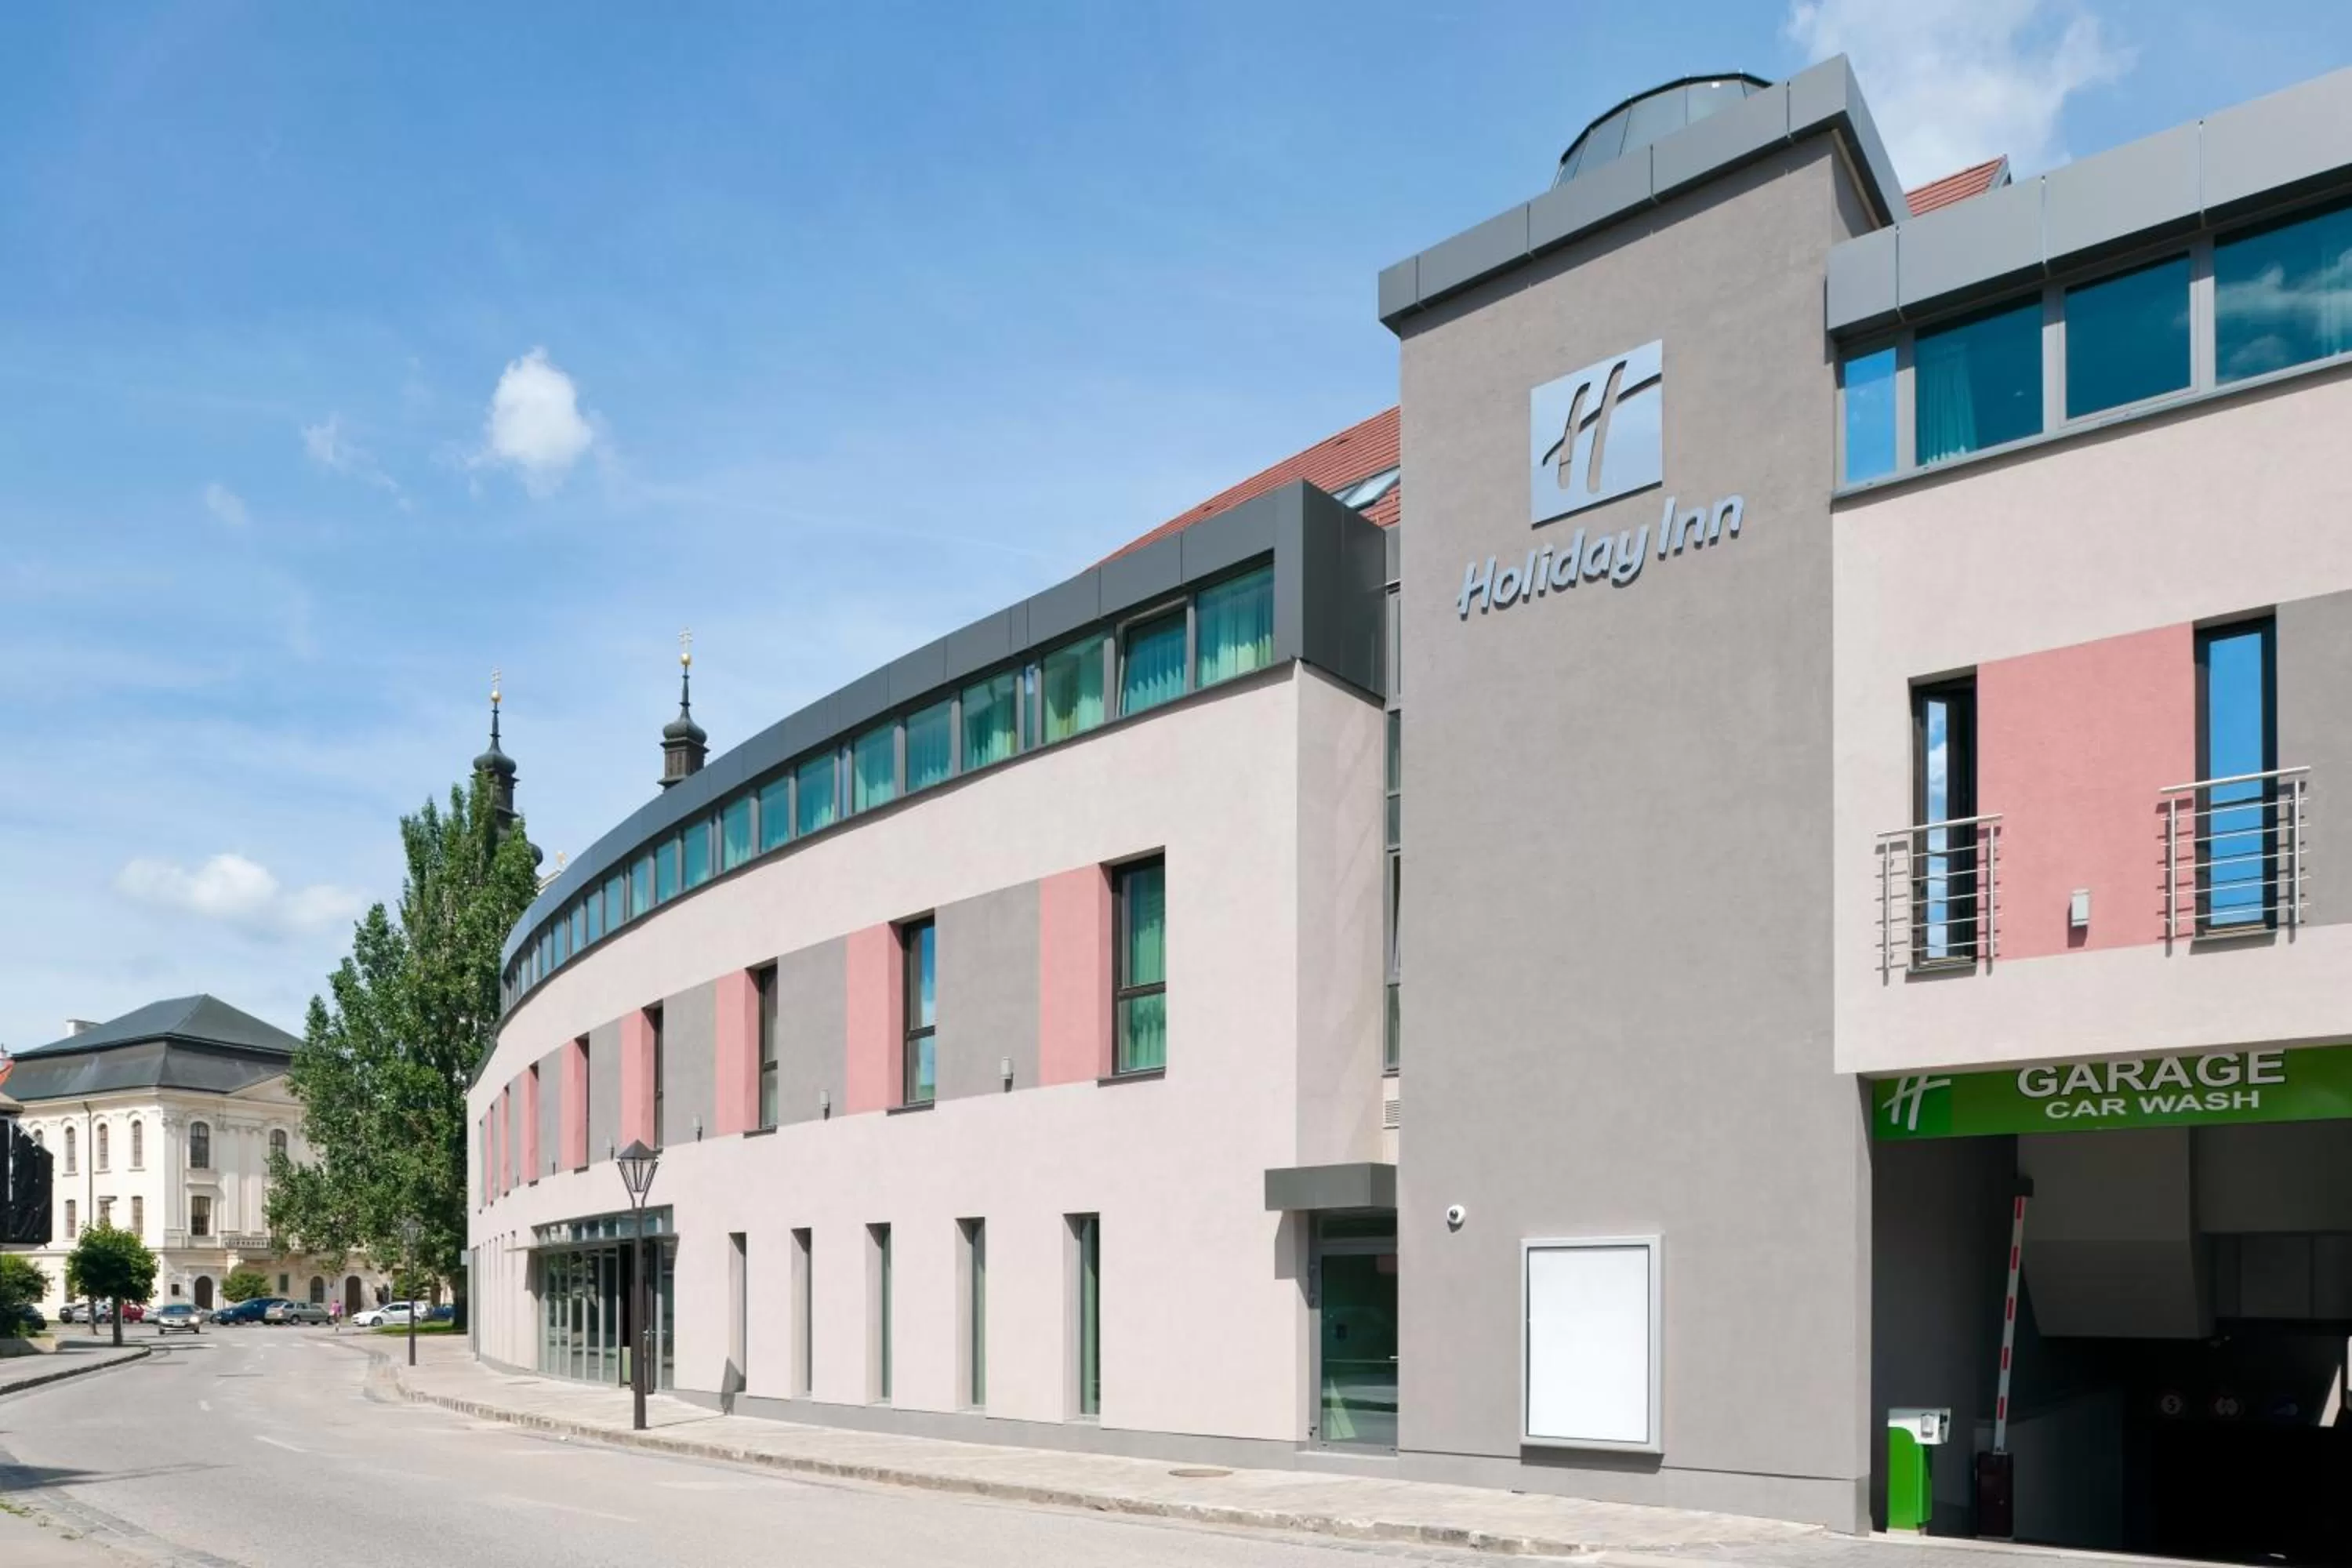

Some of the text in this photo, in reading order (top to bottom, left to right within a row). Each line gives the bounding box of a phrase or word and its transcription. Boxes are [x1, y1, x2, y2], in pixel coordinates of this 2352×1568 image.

[1457, 495, 1744, 619] Holiday Inn
[2016, 1049, 2285, 1098] GARAGE
[2045, 1090, 2259, 1119] CAR WASH
